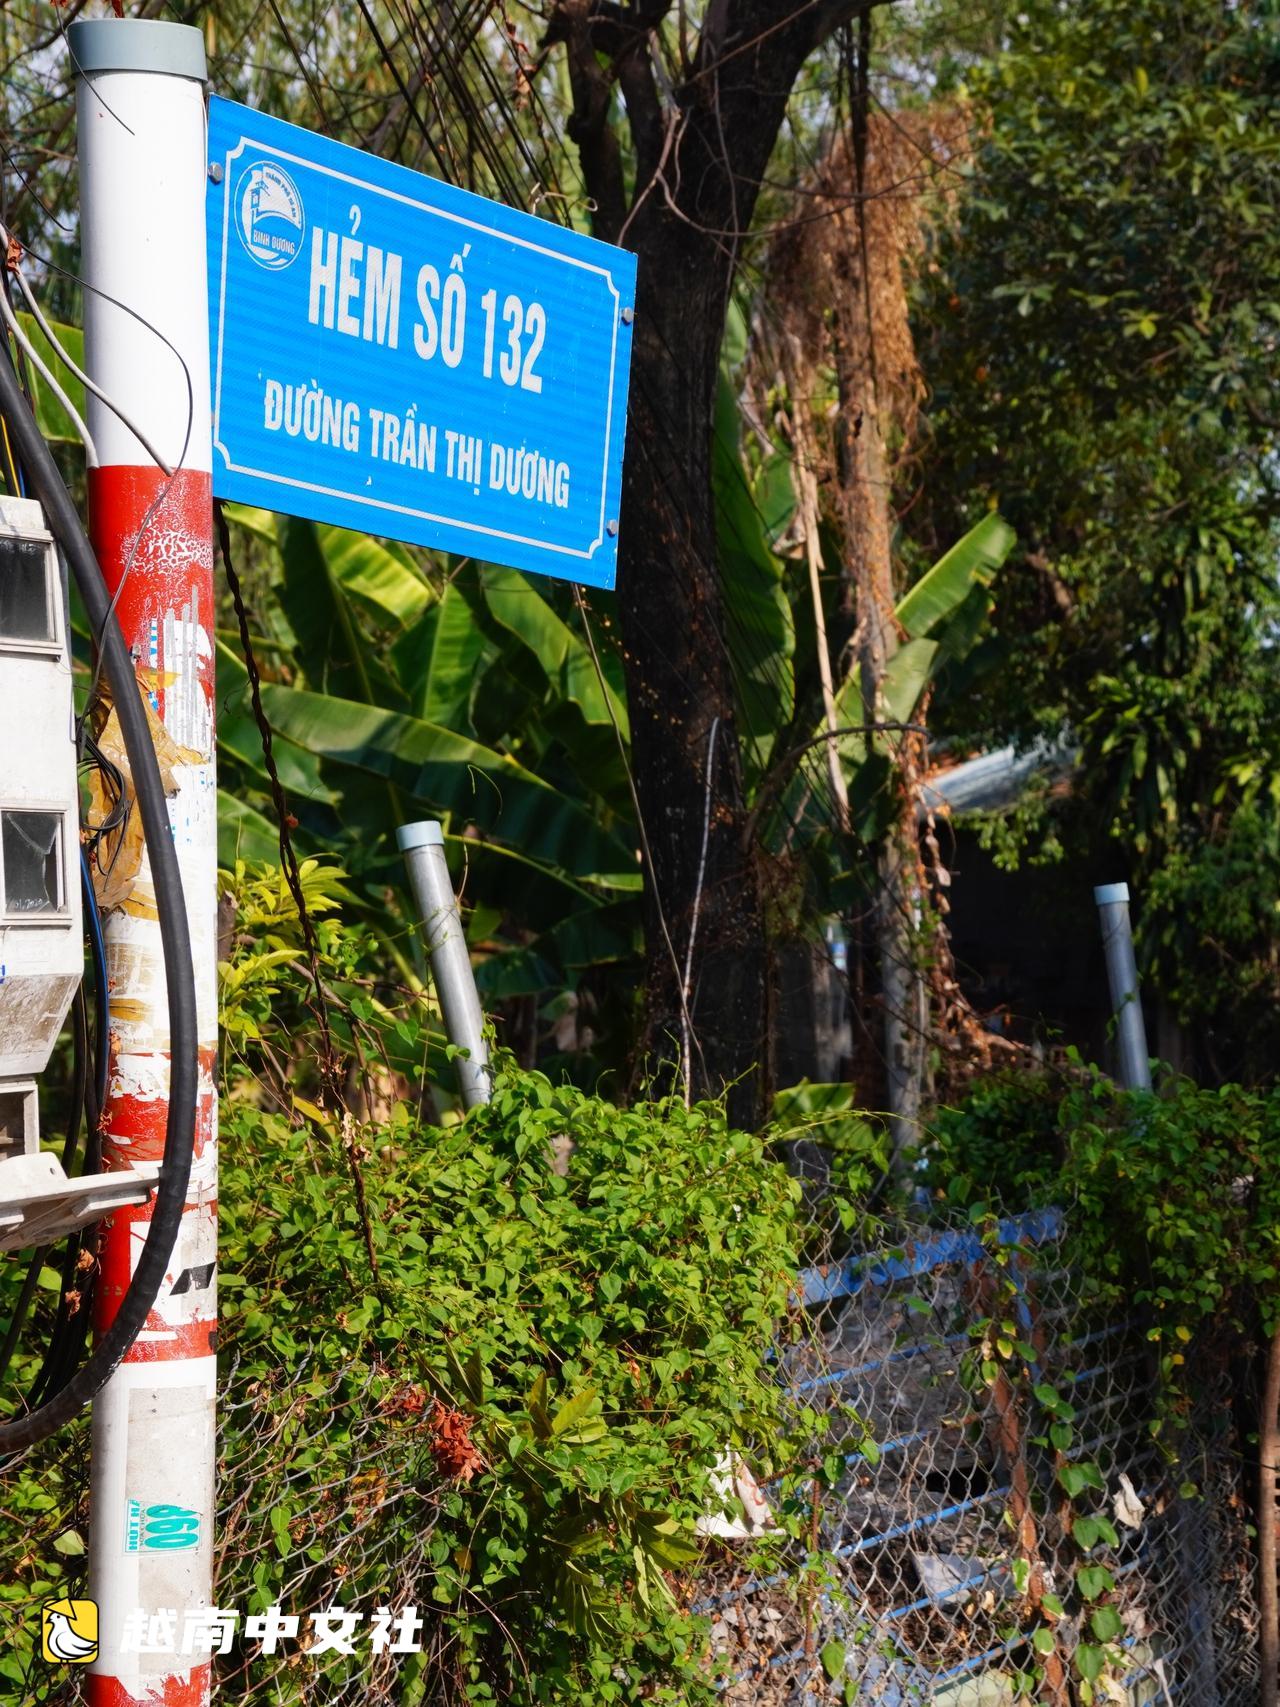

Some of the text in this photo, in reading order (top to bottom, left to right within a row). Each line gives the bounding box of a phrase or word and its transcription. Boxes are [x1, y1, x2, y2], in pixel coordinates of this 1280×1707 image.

[308, 204, 547, 394] HẺM SỐ 132
[263, 377, 570, 509] ĐƯỜNG TRẦN THỊ DƯƠNG
